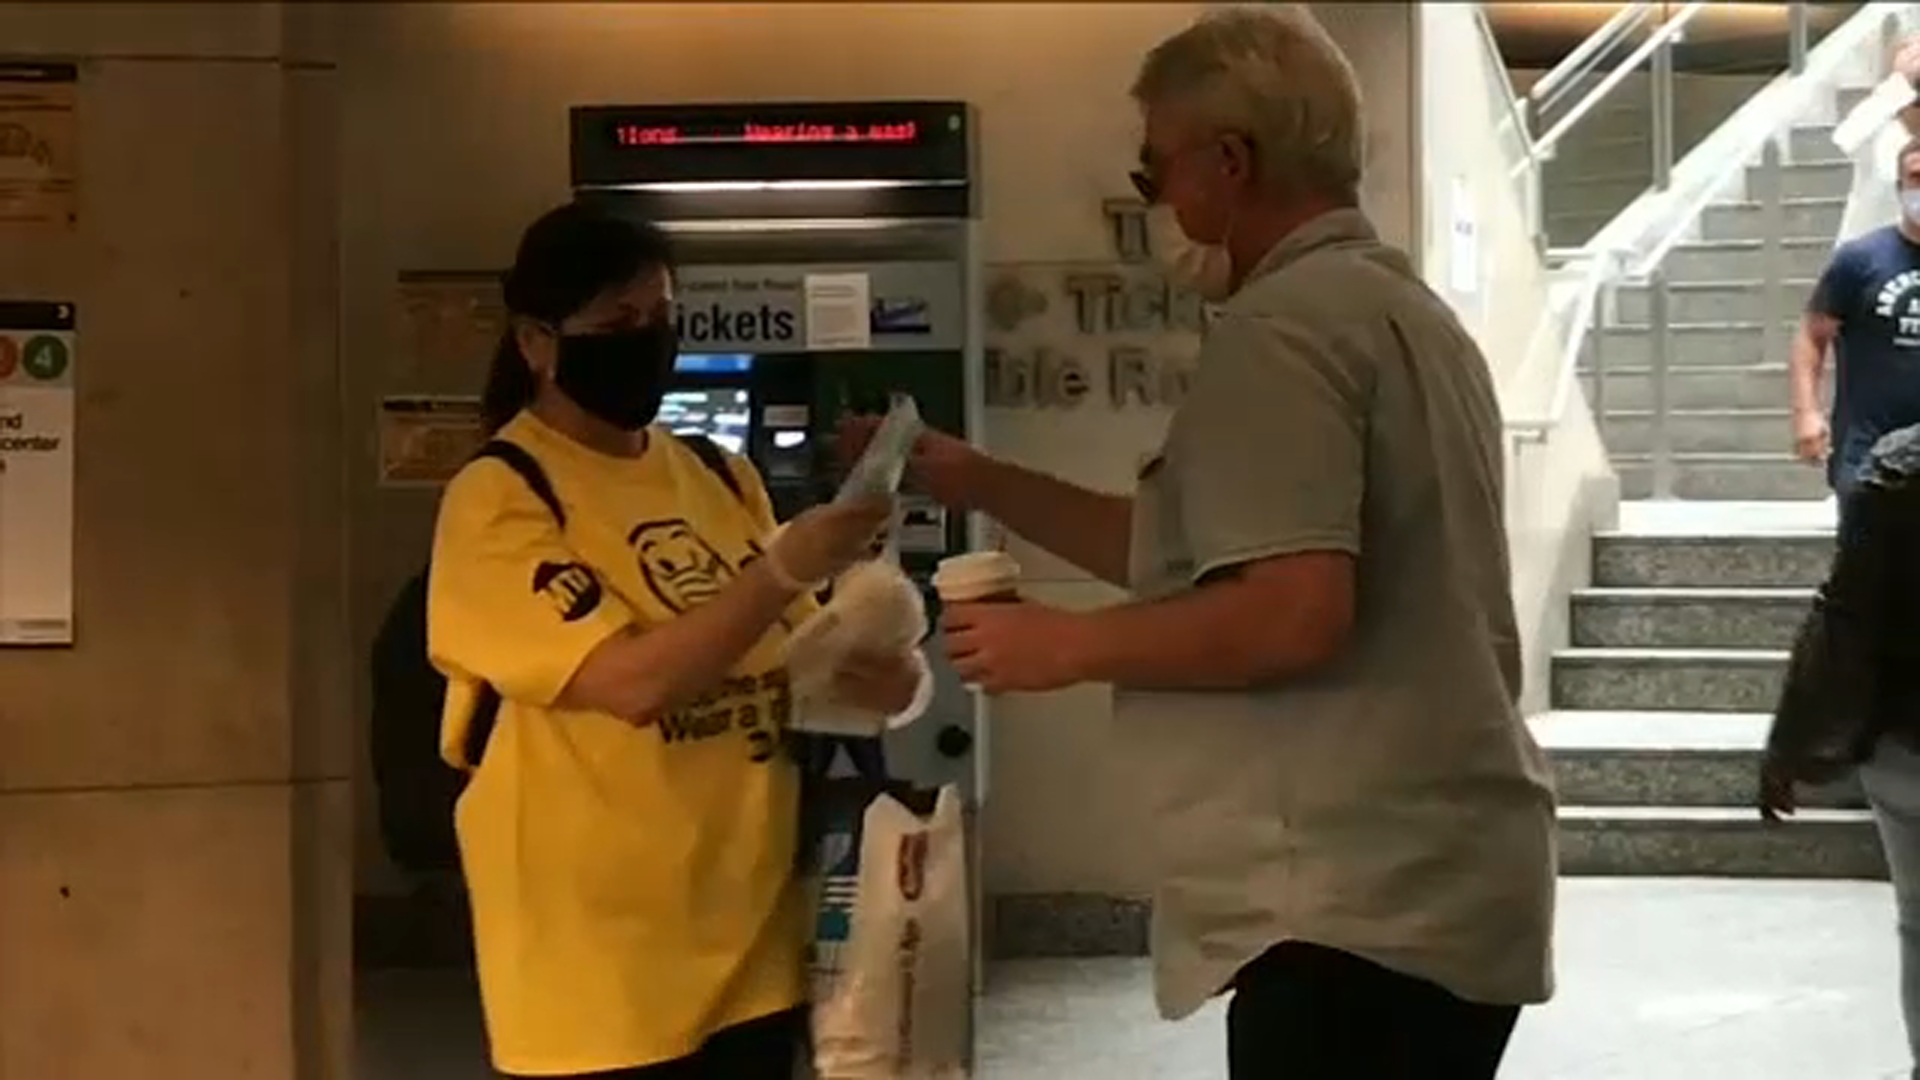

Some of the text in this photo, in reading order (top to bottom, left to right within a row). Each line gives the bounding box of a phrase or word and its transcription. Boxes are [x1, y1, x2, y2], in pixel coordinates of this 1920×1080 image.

[1065, 272, 1205, 335] Tick
[676, 303, 795, 341] ickets
[0, 435, 60, 451] center
[738, 704, 757, 728] a
